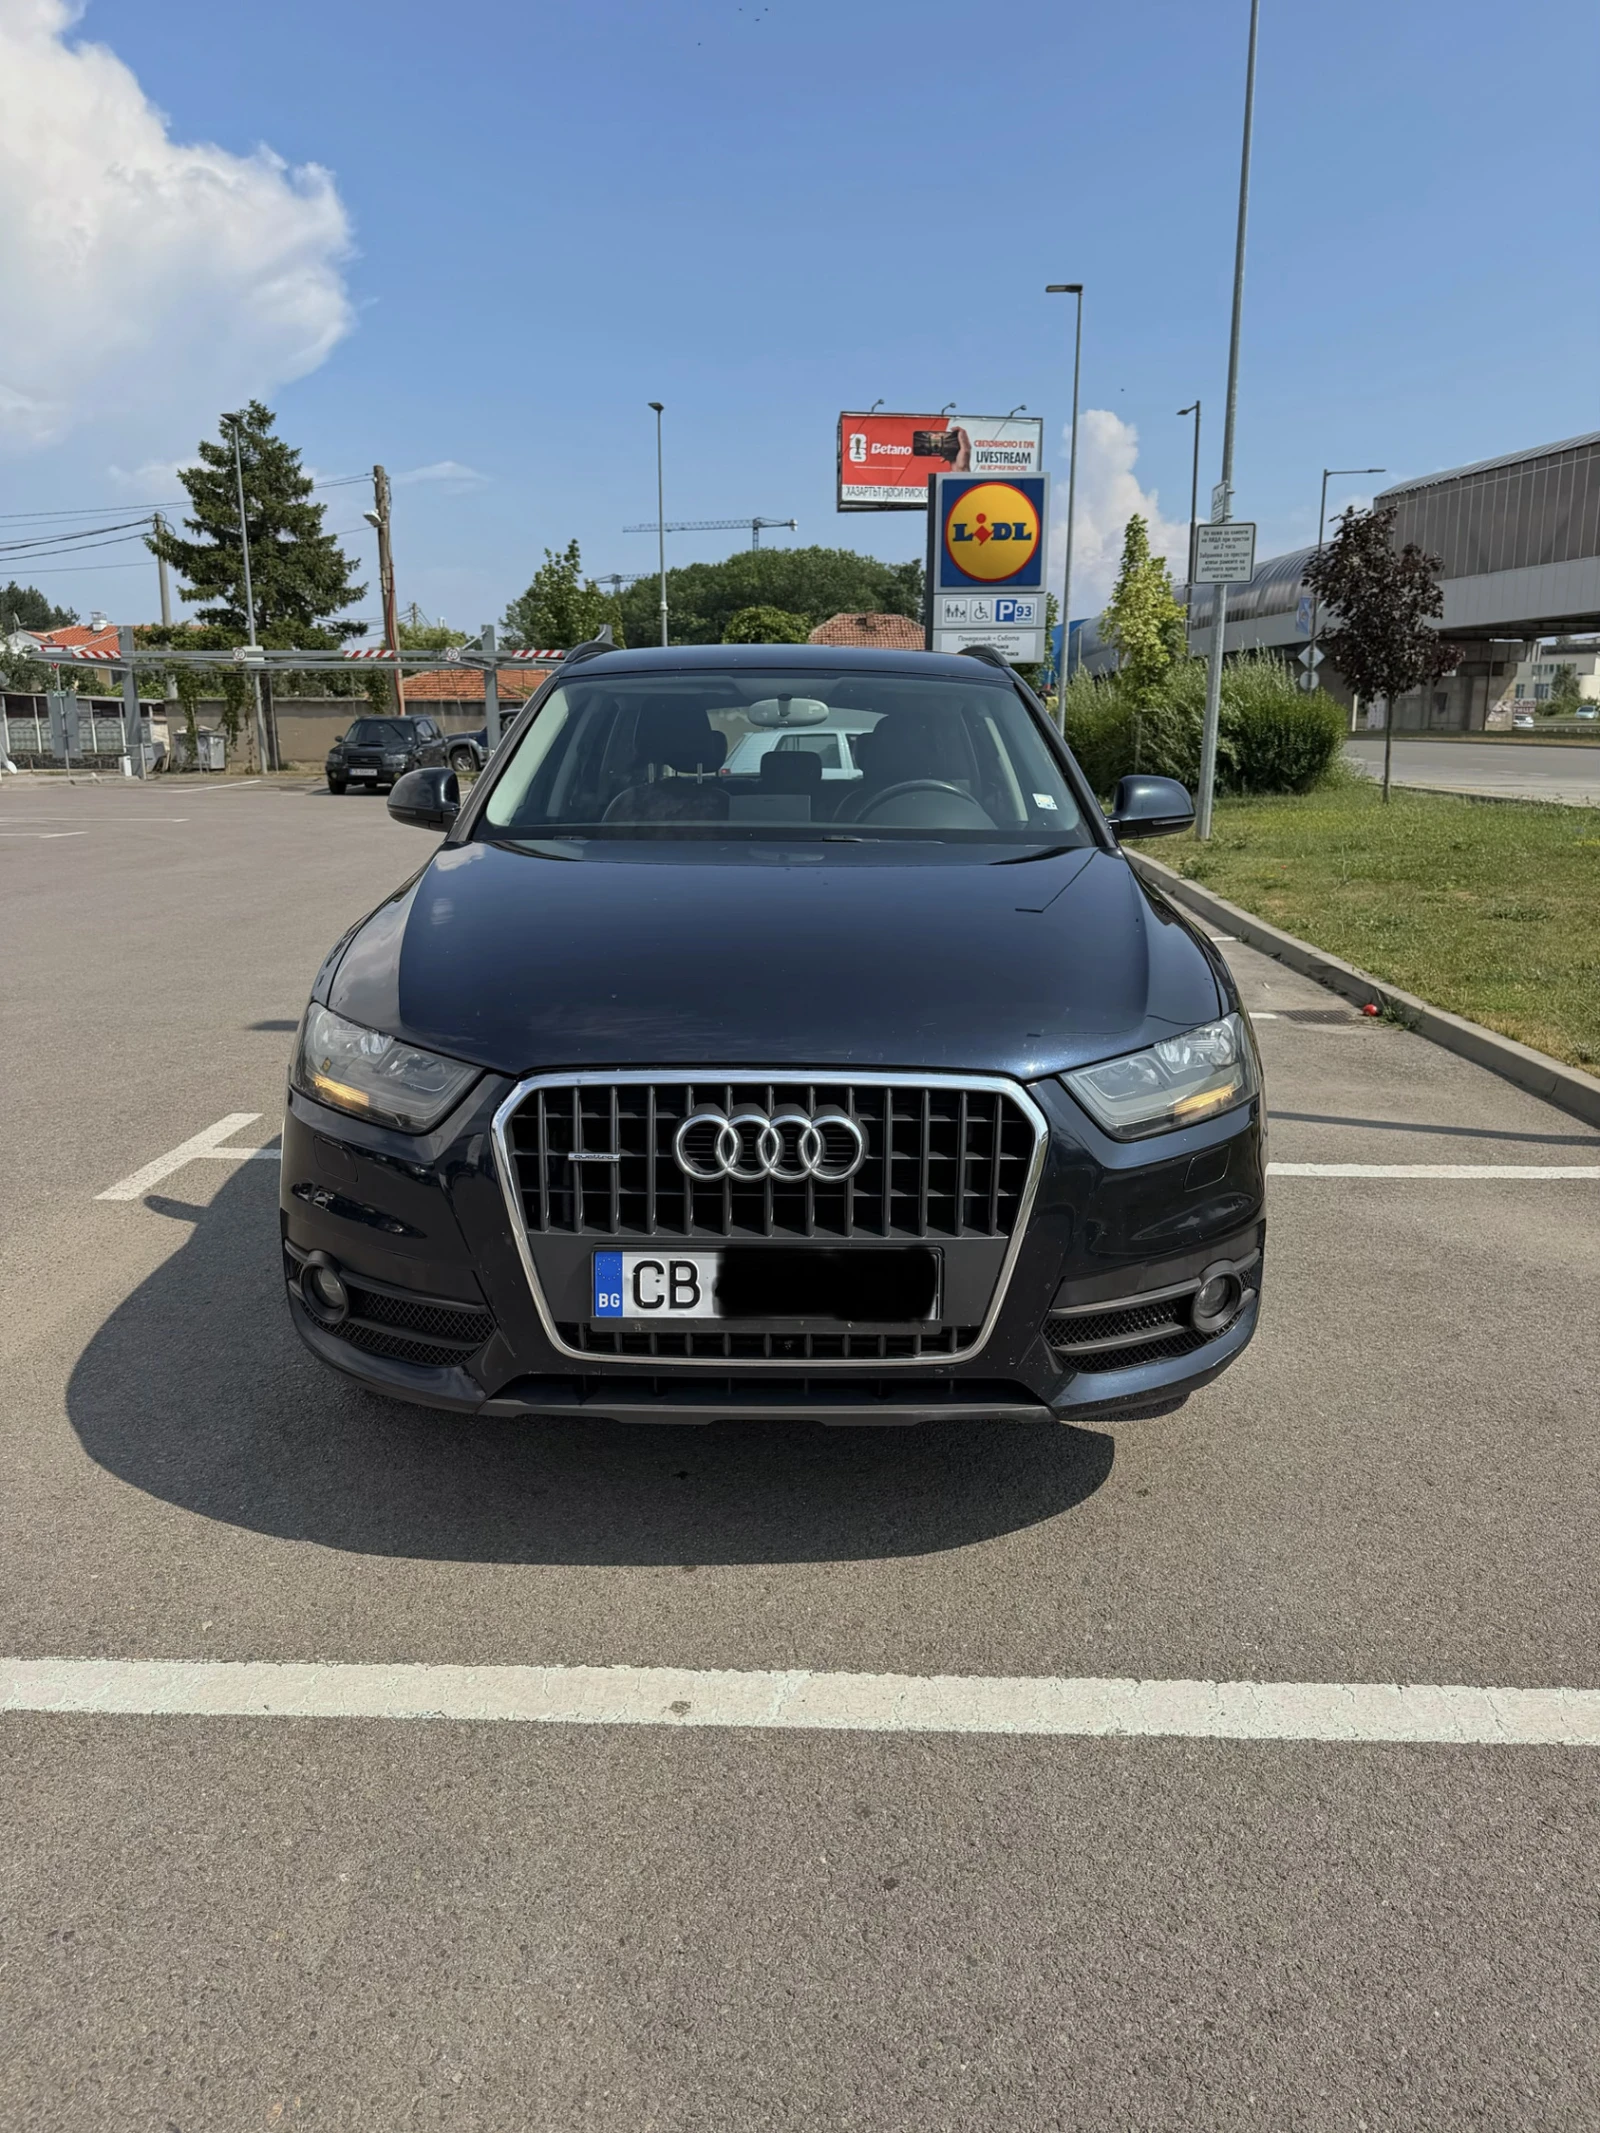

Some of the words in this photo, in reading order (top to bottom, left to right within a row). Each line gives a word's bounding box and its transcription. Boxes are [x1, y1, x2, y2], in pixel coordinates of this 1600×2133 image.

[870, 443, 912, 455] Betano
[976, 451, 1032, 464] LIVESTREAM
[846, 486, 882, 497] ХАЗАРТЪТ
[883, 487, 904, 498] НОСИ
[905, 488, 923, 499] РИСК
[999, 601, 1014, 620] P
[1016, 605, 1032, 617] 93
[599, 1293, 620, 1308] BG
